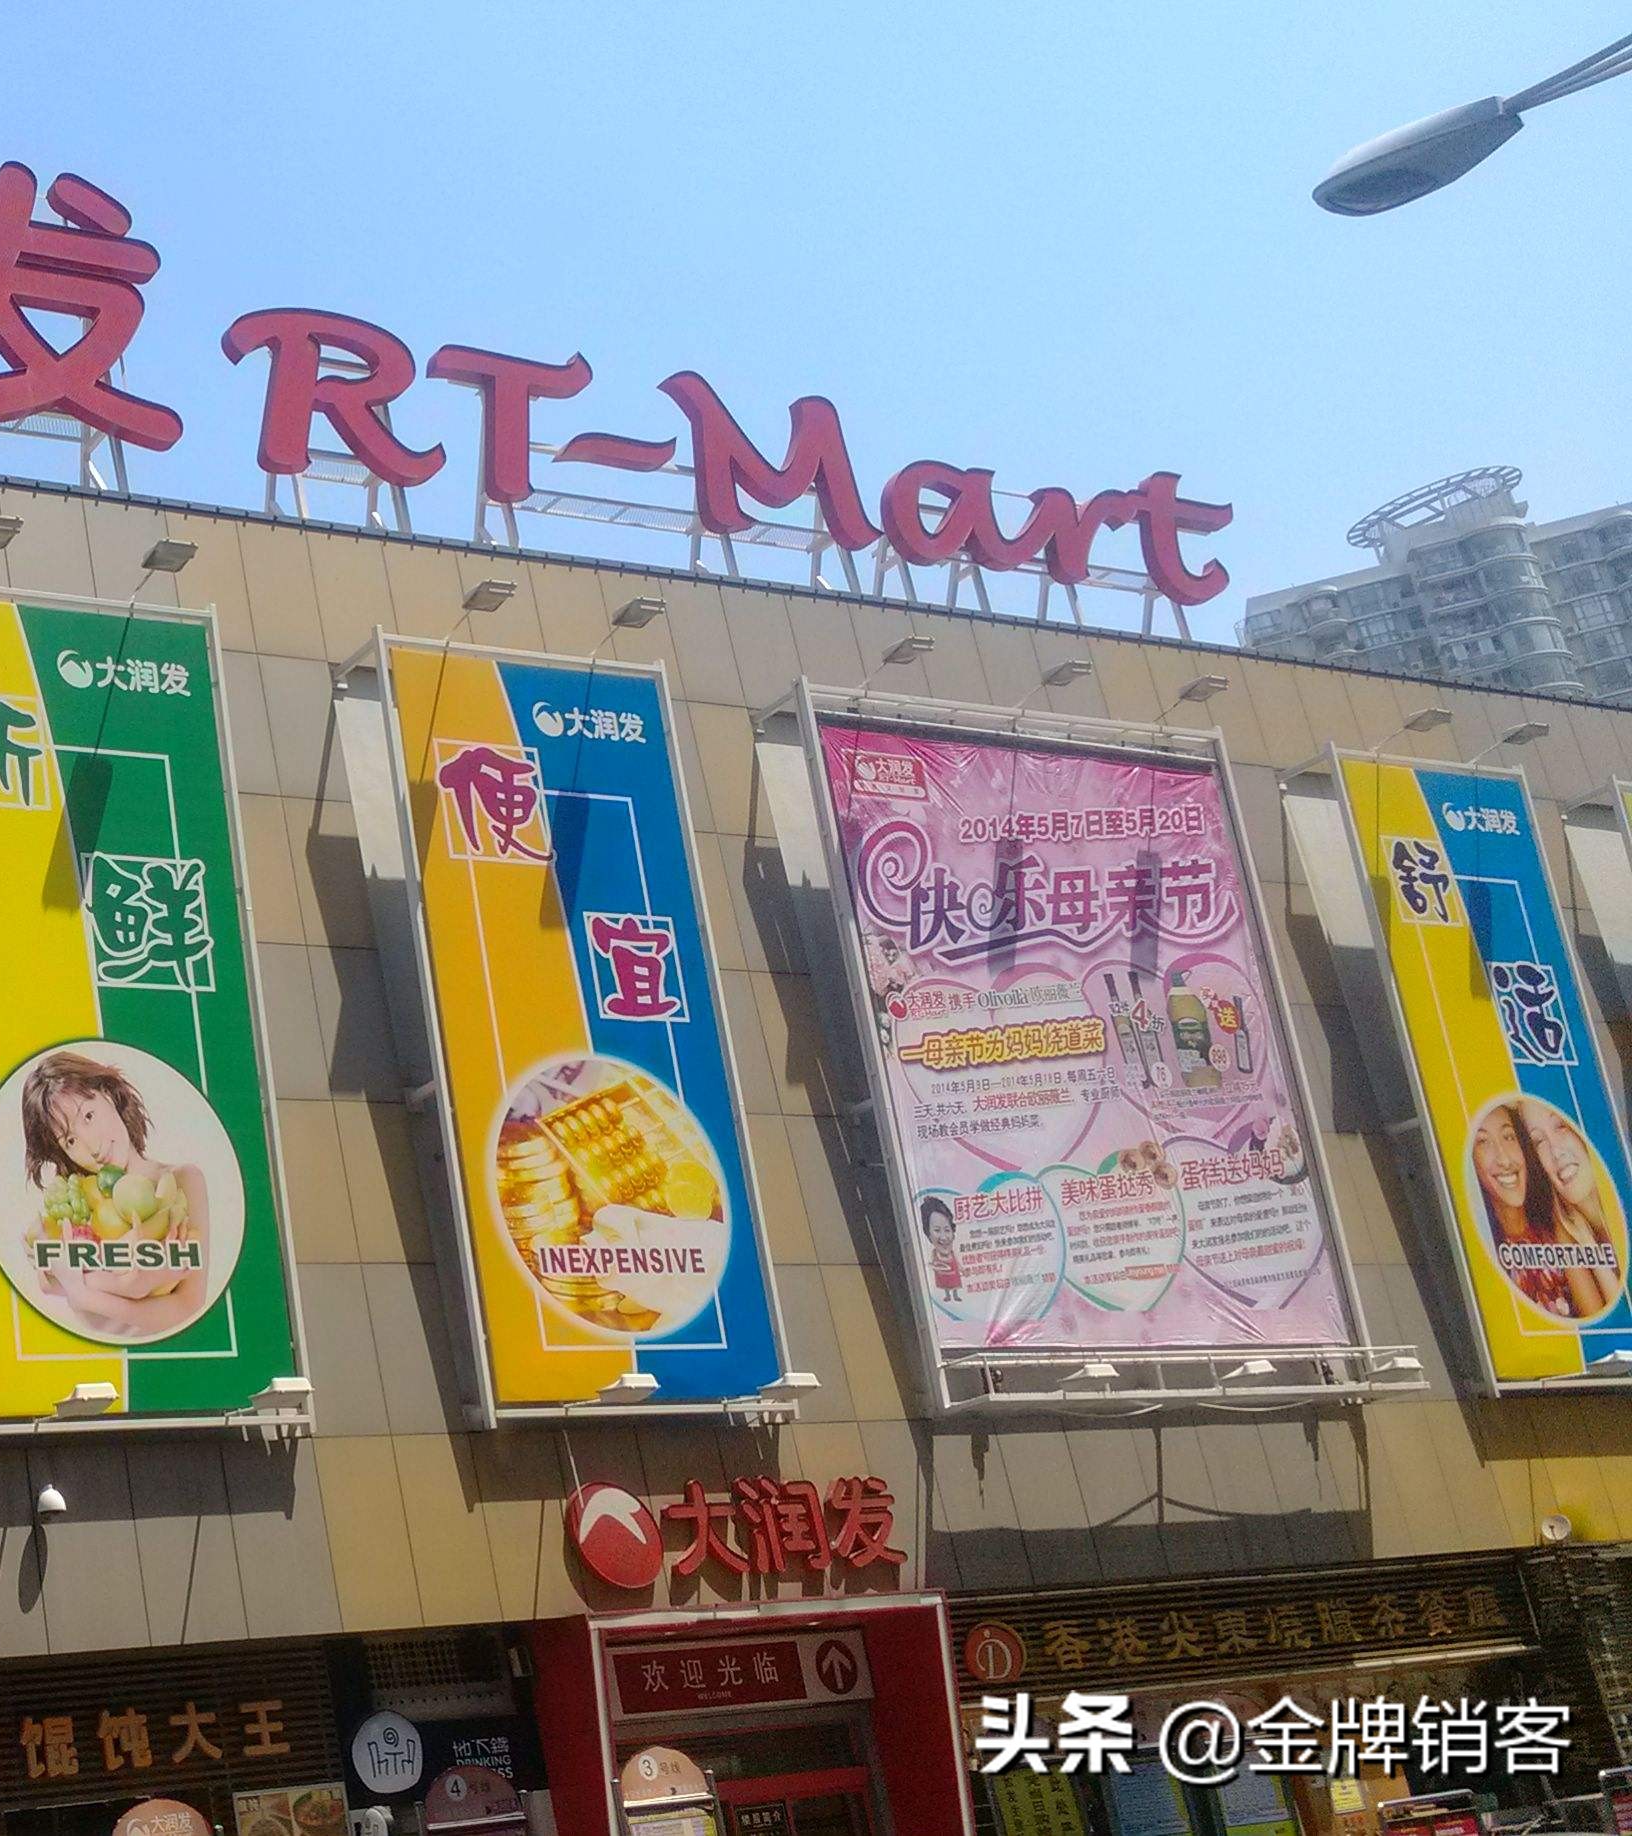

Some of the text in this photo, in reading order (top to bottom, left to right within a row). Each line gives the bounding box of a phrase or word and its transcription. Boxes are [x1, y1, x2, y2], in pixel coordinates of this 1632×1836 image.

[221, 307, 1232, 606] RT-Mart
[96, 654, 191, 698] 大润发
[564, 706, 647, 745] 大润发
[436, 746, 555, 862] 便
[960, 803, 1206, 843] 2014年5月7日至5月20日
[1465, 806, 1520, 836] 大润发
[1391, 838, 1451, 923] 舒
[87, 854, 215, 992] 鲜
[898, 853, 1218, 955] 快乐母亲节
[589, 912, 684, 1021] 宜
[908, 990, 945, 1010] 大润发
[1061, 1169, 1155, 1207] 美味蛋挞秀
[1181, 1149, 1286, 1192] 蛋糕送妈妈
[954, 1187, 1043, 1222] 厨艺大比拼
[35, 1239, 202, 1270] FRESH
[539, 1246, 705, 1275] INEXPENSIVE
[1500, 1243, 1616, 1269] COMFORTABLE
[662, 1476, 908, 1575] 大润发
[641, 1652, 780, 1692] 欢迎光临
[20, 1700, 290, 1779] 馄饨大王
